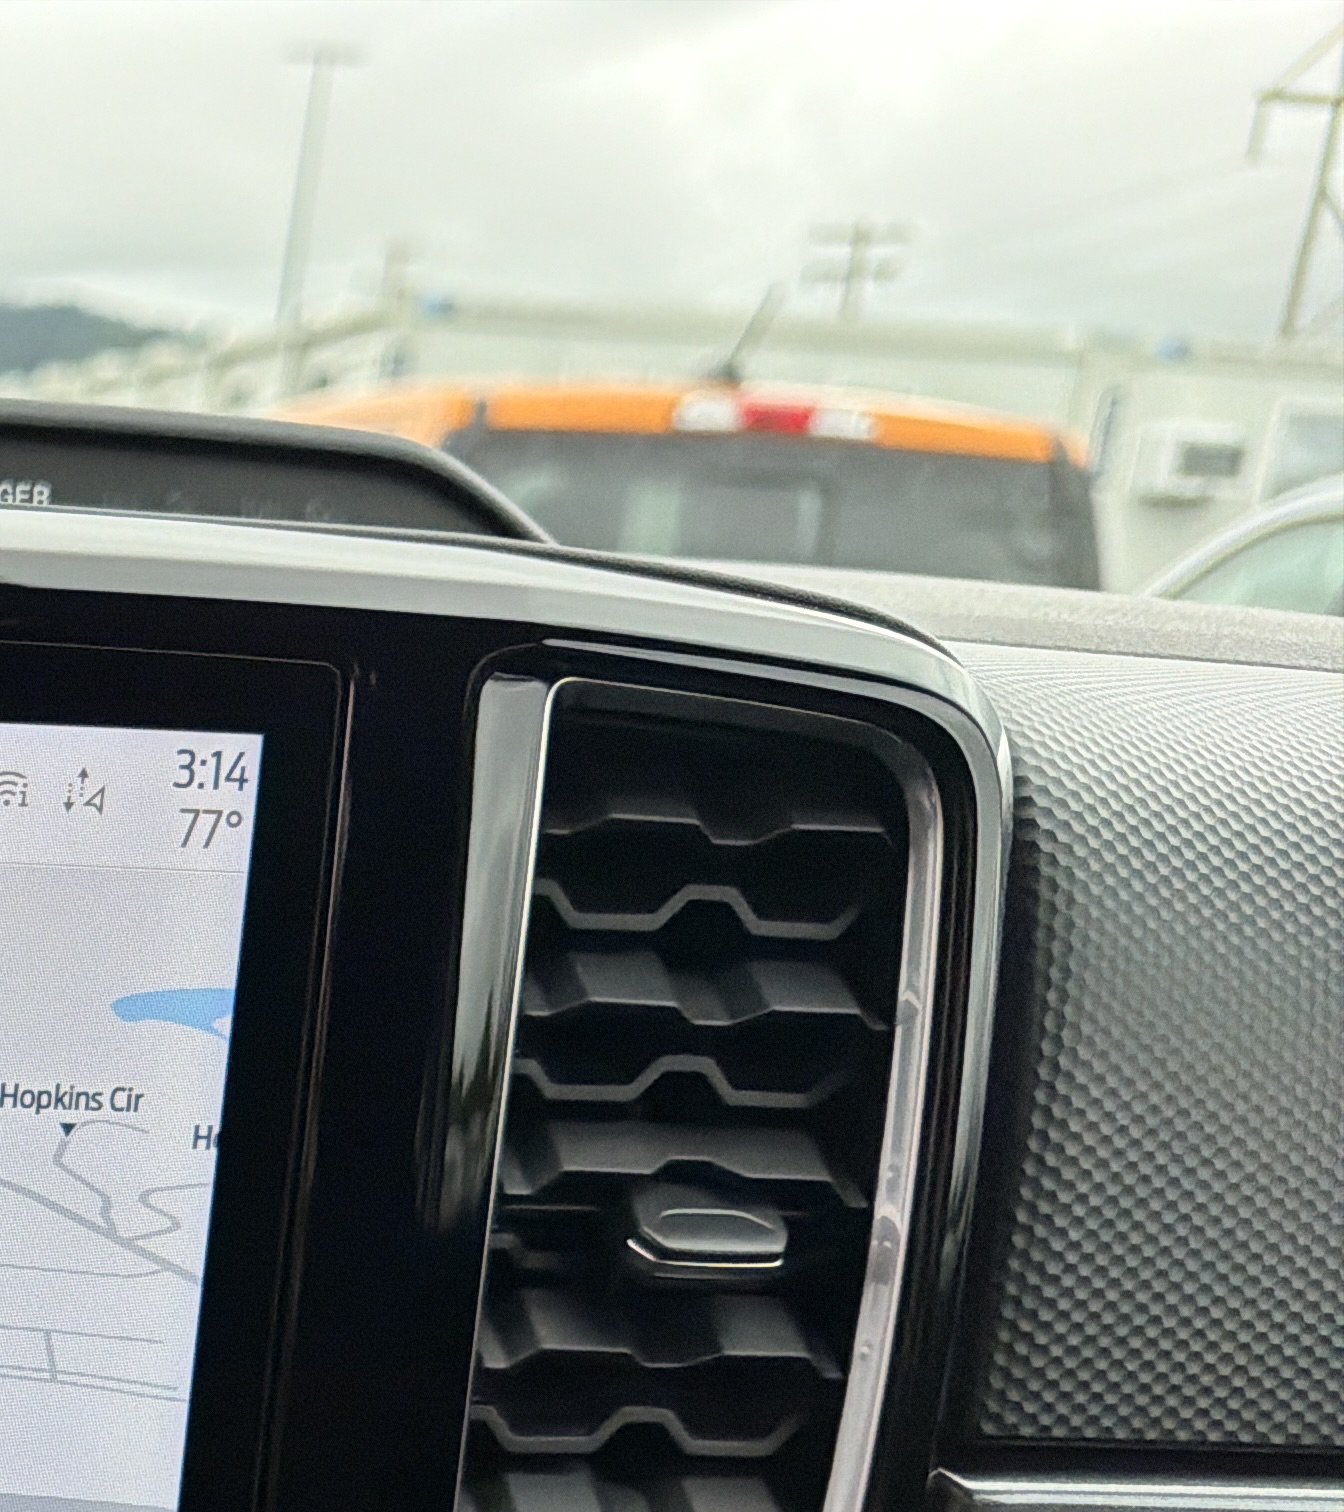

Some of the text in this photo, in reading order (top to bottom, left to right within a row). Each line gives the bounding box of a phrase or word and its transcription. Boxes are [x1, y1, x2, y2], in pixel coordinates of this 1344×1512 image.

[172, 748, 249, 792] 3:14
[179, 807, 244, 849] 77°
[109, 1086, 145, 1113] Cir
